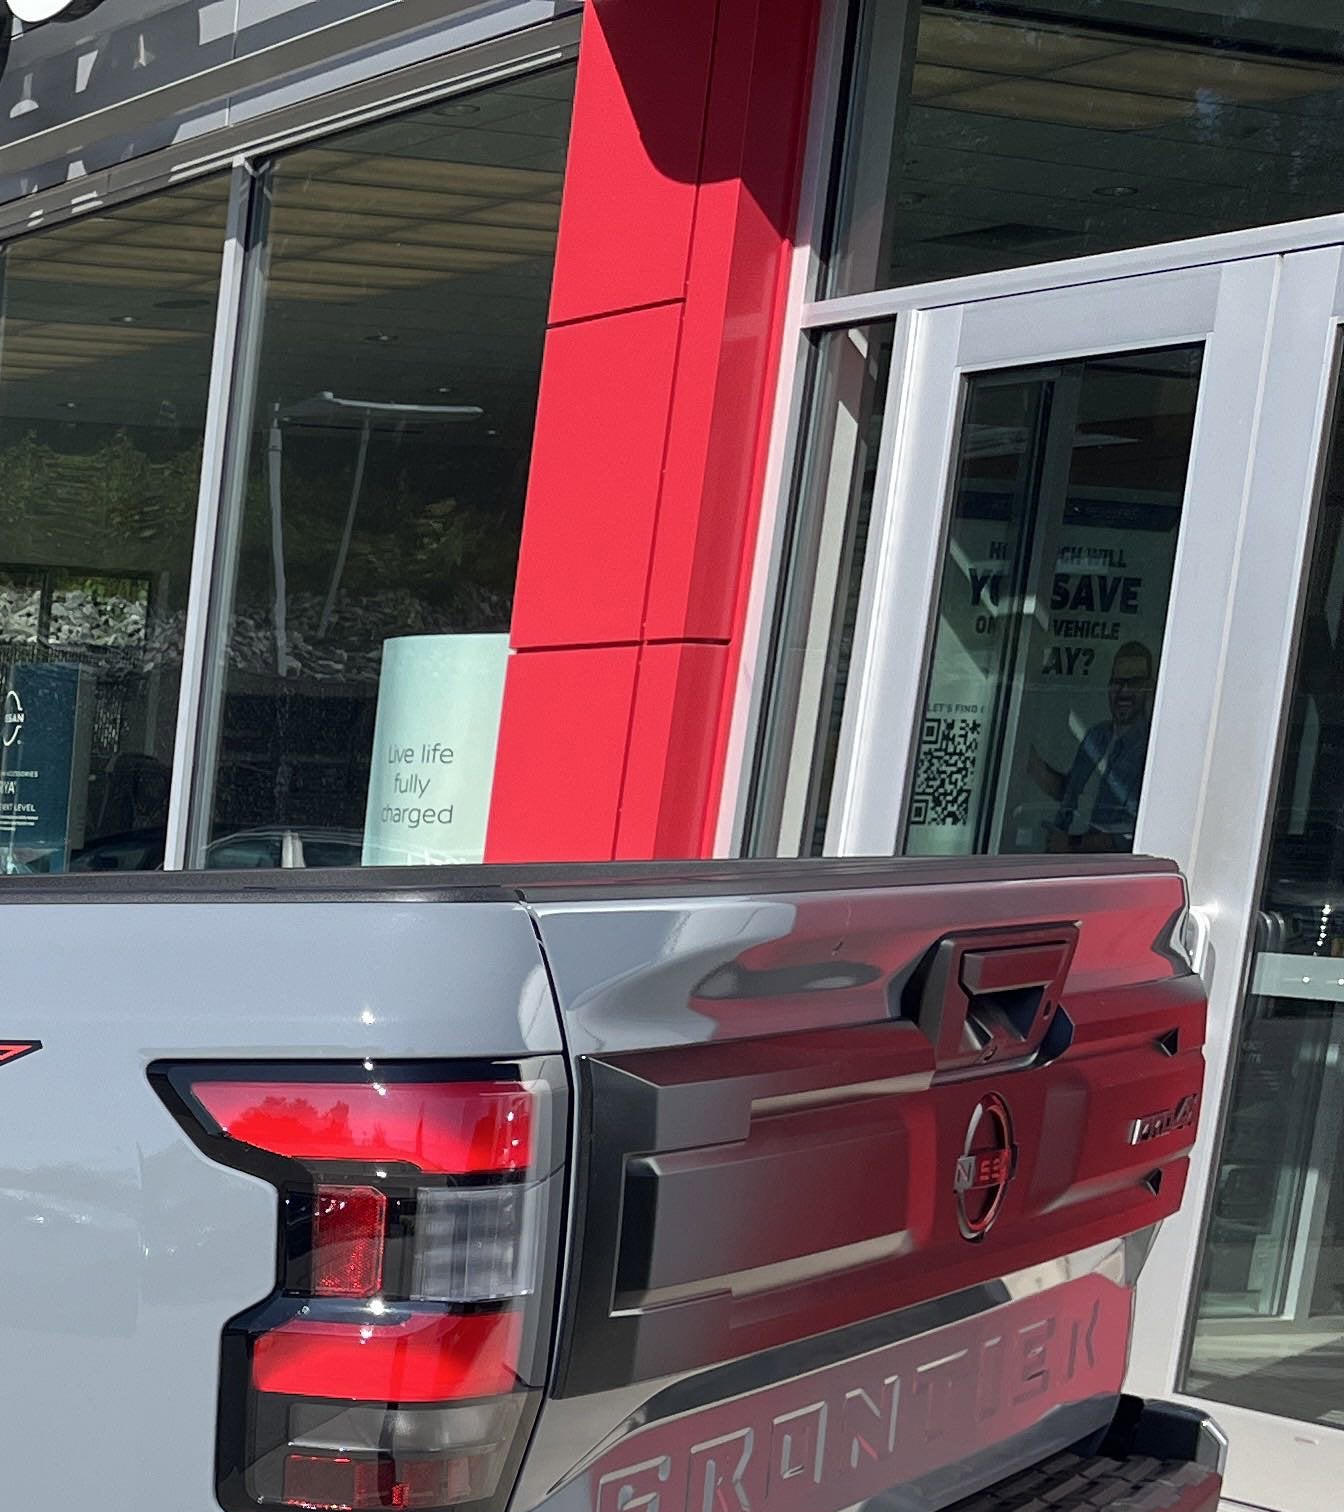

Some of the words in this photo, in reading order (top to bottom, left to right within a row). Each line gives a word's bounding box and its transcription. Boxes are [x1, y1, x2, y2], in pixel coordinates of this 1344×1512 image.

[1050, 573, 1142, 615] SAVE
[1053, 618, 1121, 640] VEHICLE
[388, 743, 415, 764] Live
[421, 742, 454, 764] life
[394, 772, 431, 799] fully
[13, 803, 36, 812] LEVEL
[380, 804, 454, 829] charged
